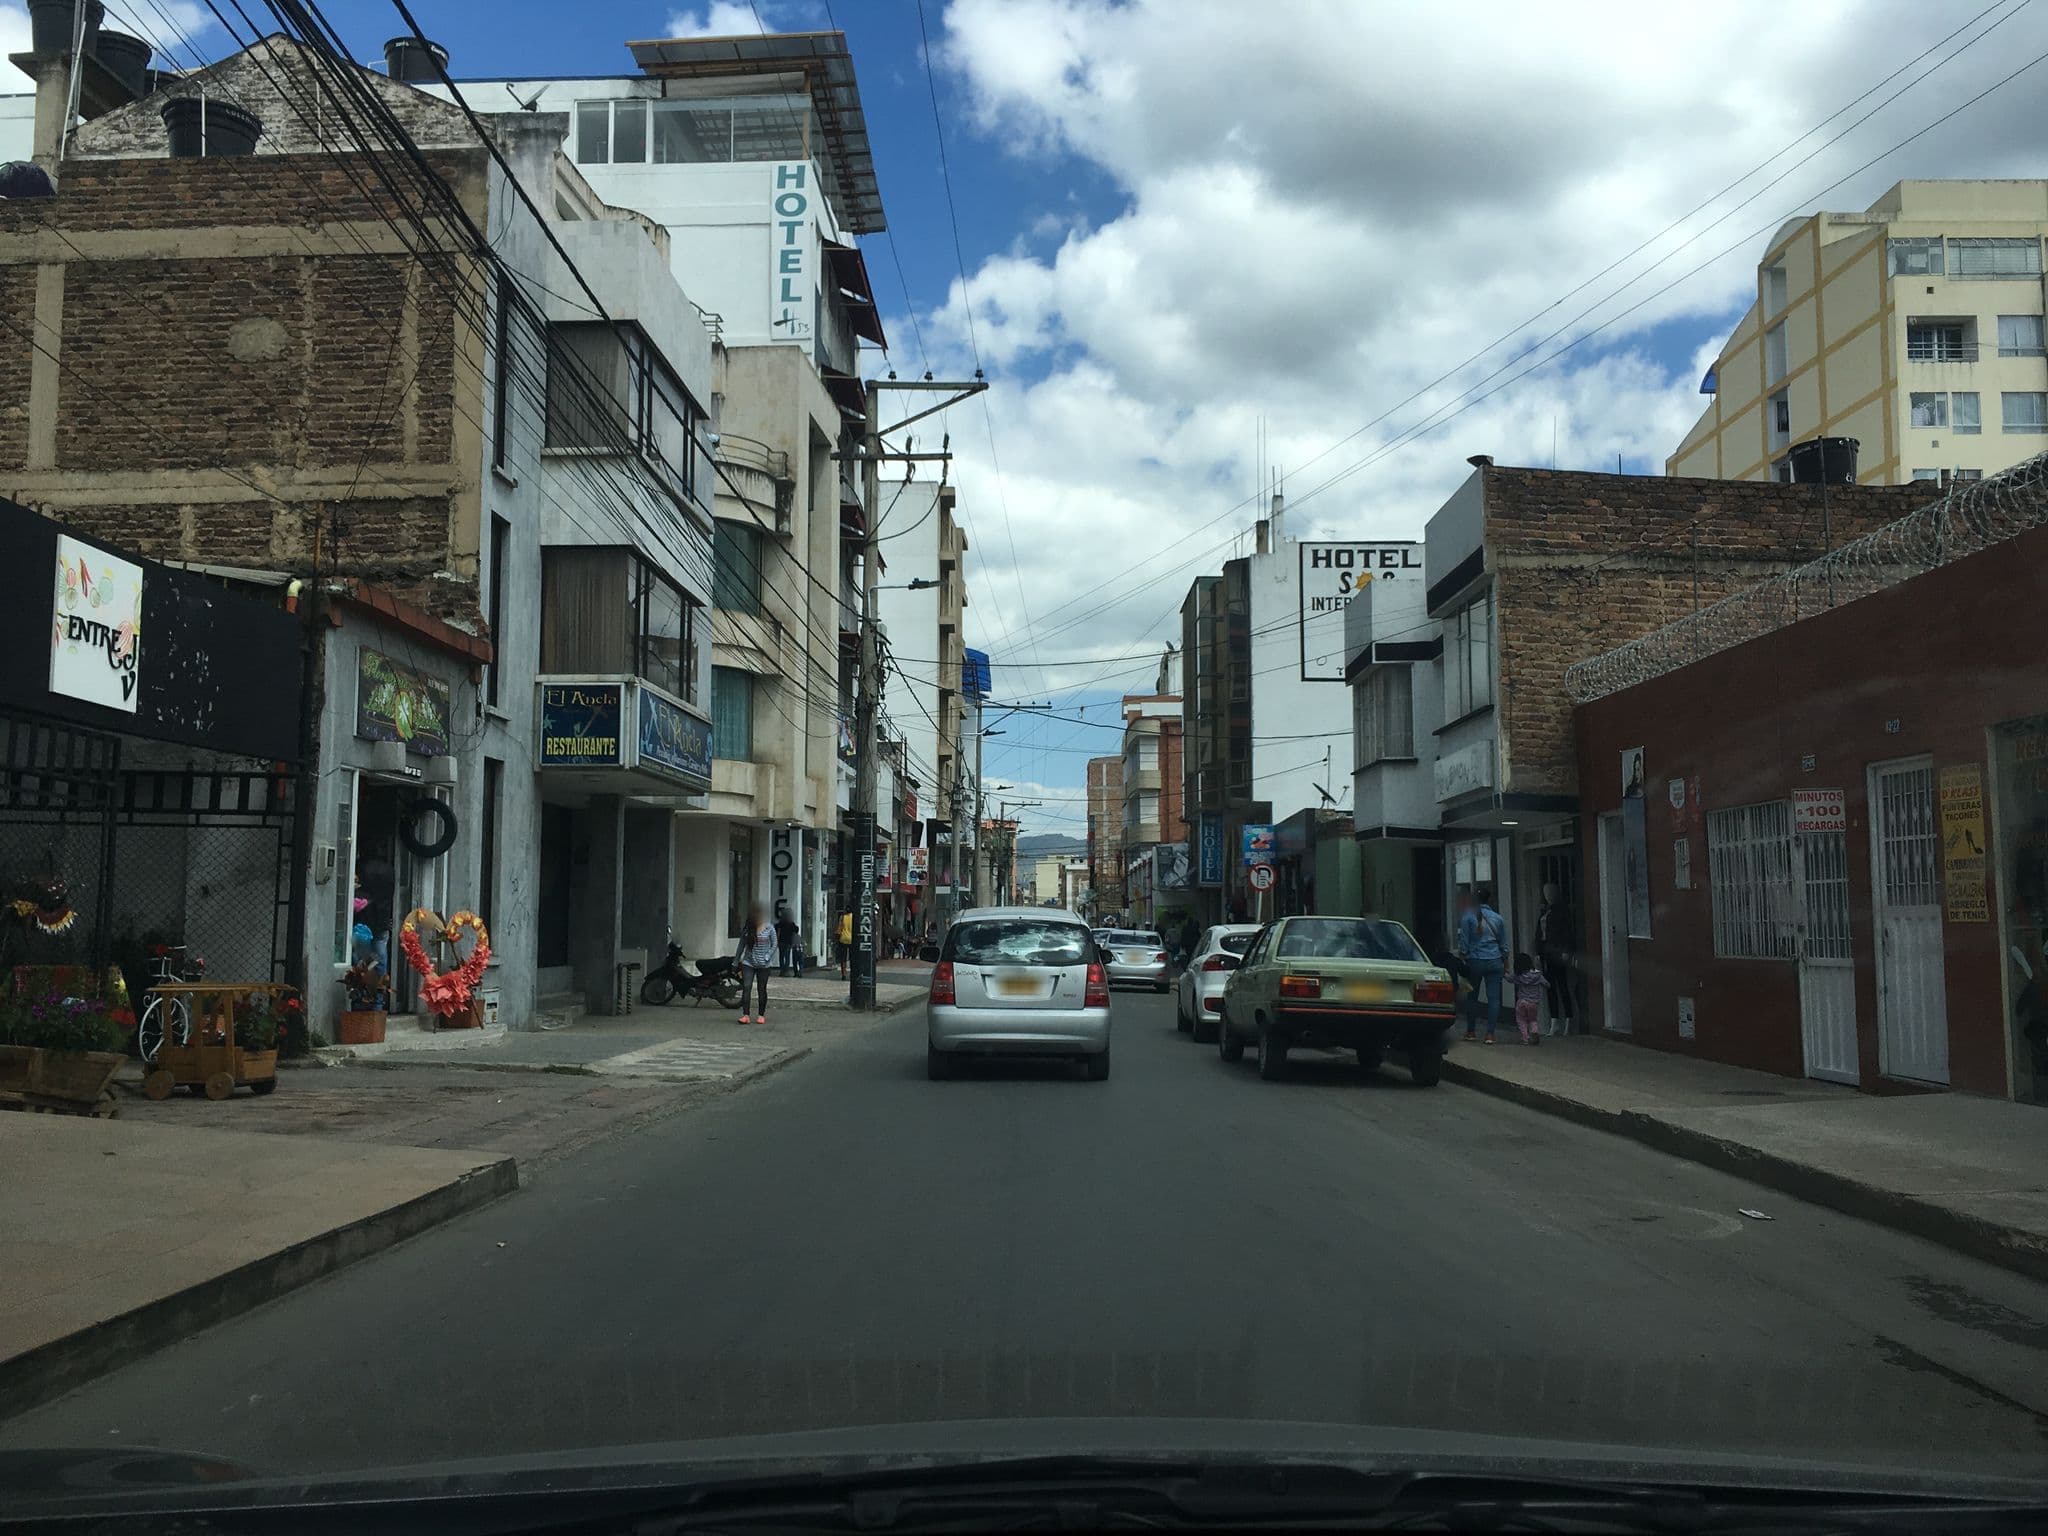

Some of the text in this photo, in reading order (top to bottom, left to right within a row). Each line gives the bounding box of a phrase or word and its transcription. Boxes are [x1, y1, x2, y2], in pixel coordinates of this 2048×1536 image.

[775, 165, 807, 302] HOTEL
[1311, 549, 1422, 568] HOTEL
[69, 615, 123, 669] ENTRE
[546, 690, 617, 707] El Ancla
[546, 737, 616, 756] RESTAURANTE
[1795, 791, 1843, 802] MINUTOS
[1806, 805, 1841, 817] 100
[1945, 810, 1980, 821] TACONES
[1796, 821, 1846, 832] RECARGAS
[1204, 826, 1216, 880] HOTEL
[771, 830, 793, 919] HOTE
[860, 855, 873, 951] RESTAURANTE
[1949, 900, 1986, 909] ARREGLO
[1950, 910, 1986, 920] DE TENIS
